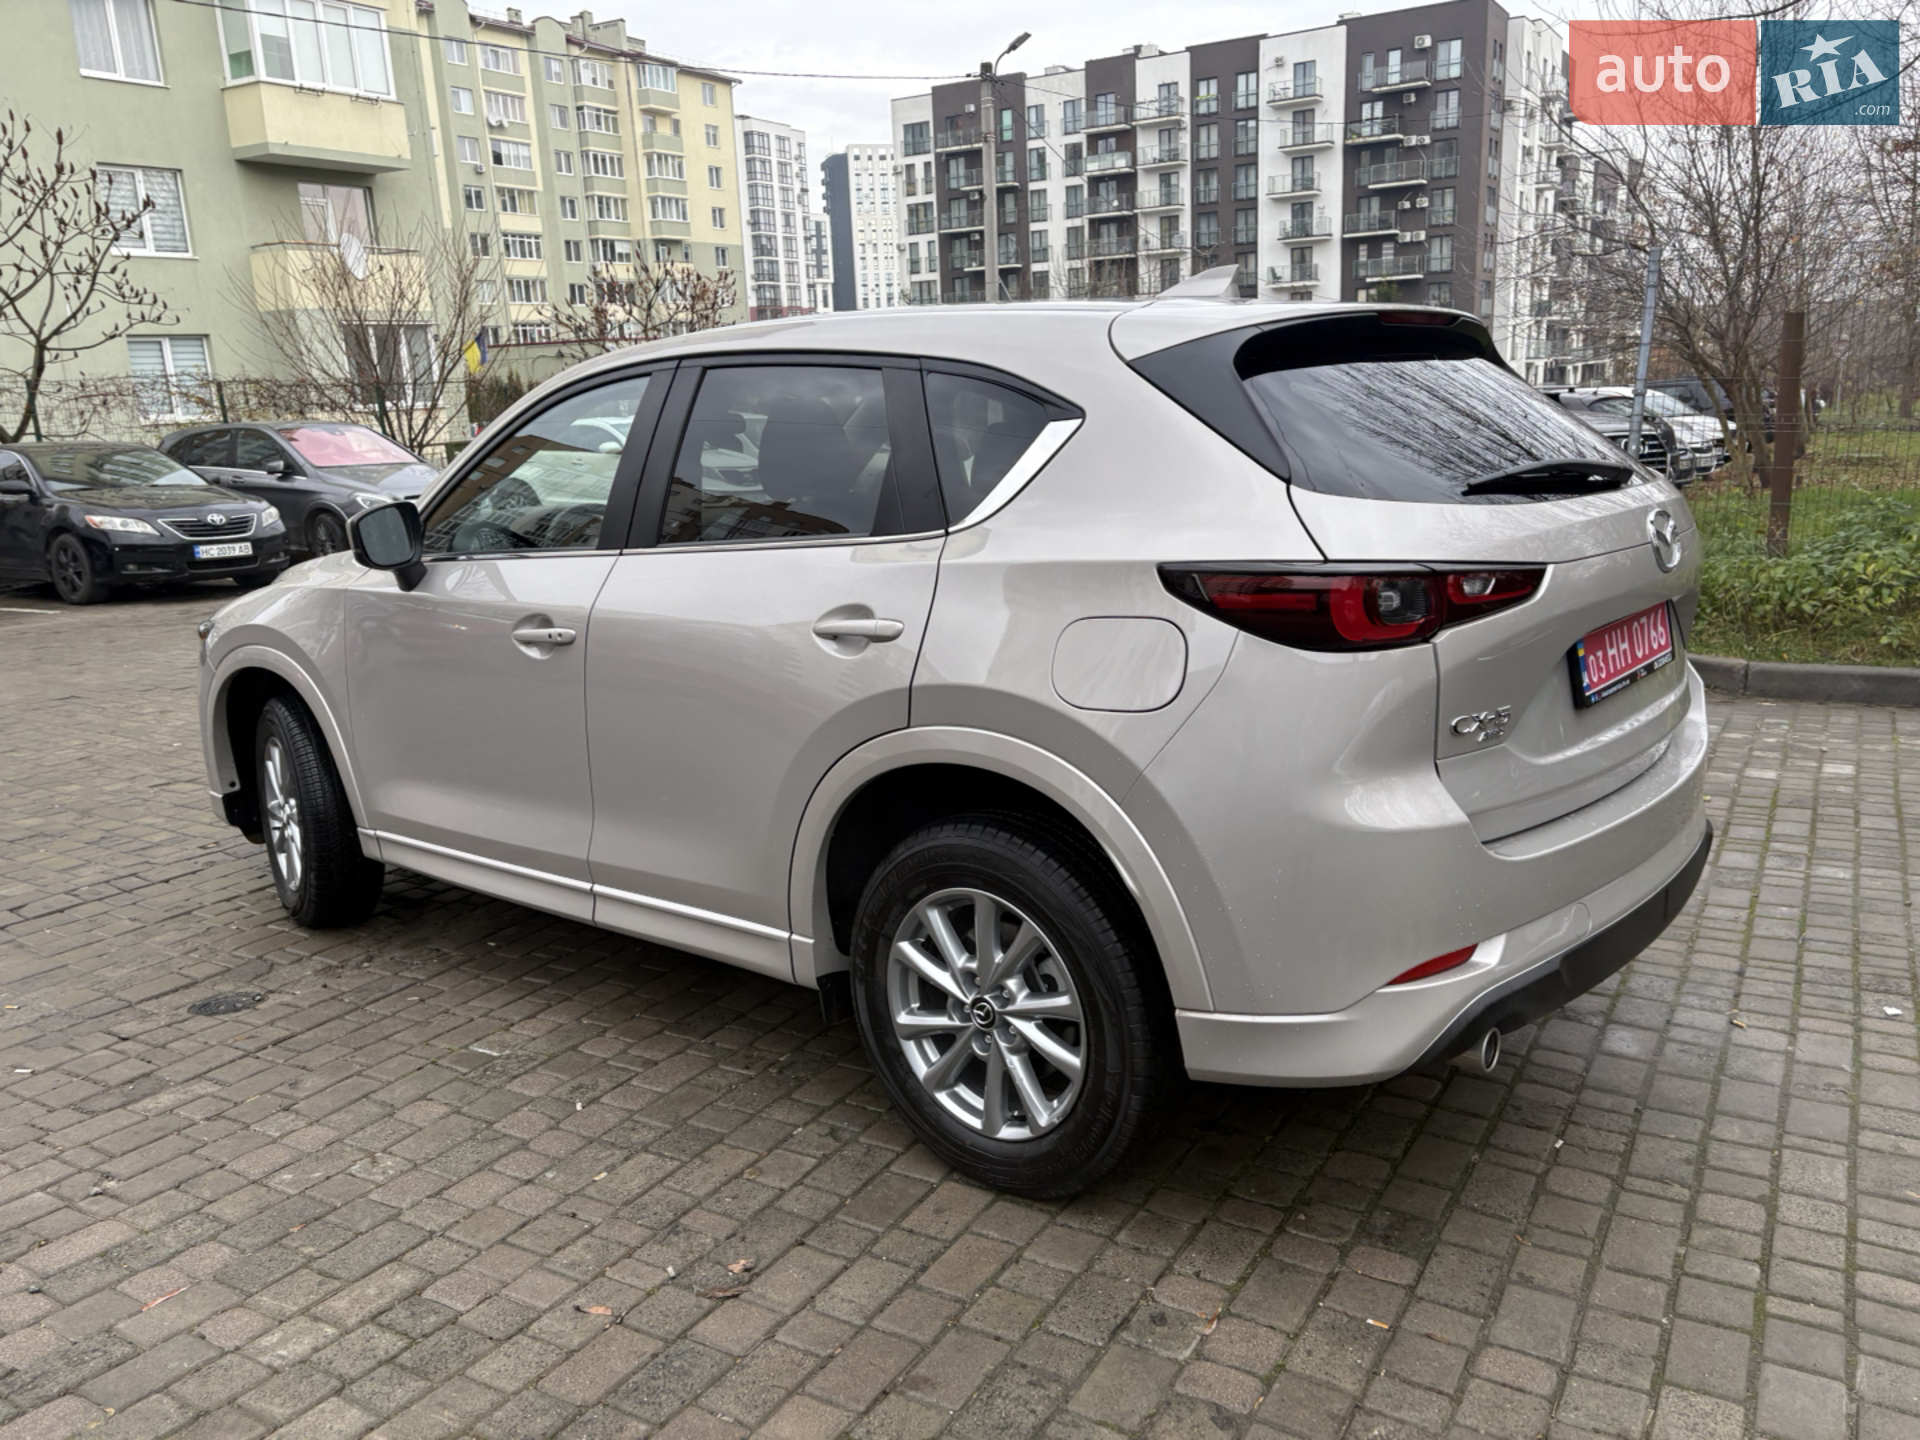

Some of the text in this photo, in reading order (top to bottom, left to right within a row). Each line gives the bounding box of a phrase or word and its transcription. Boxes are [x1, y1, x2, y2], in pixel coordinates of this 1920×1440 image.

[216, 546, 236, 556] 2039
[1588, 608, 1667, 683] 03 HH 0766
[1449, 705, 1511, 735] CX-5
